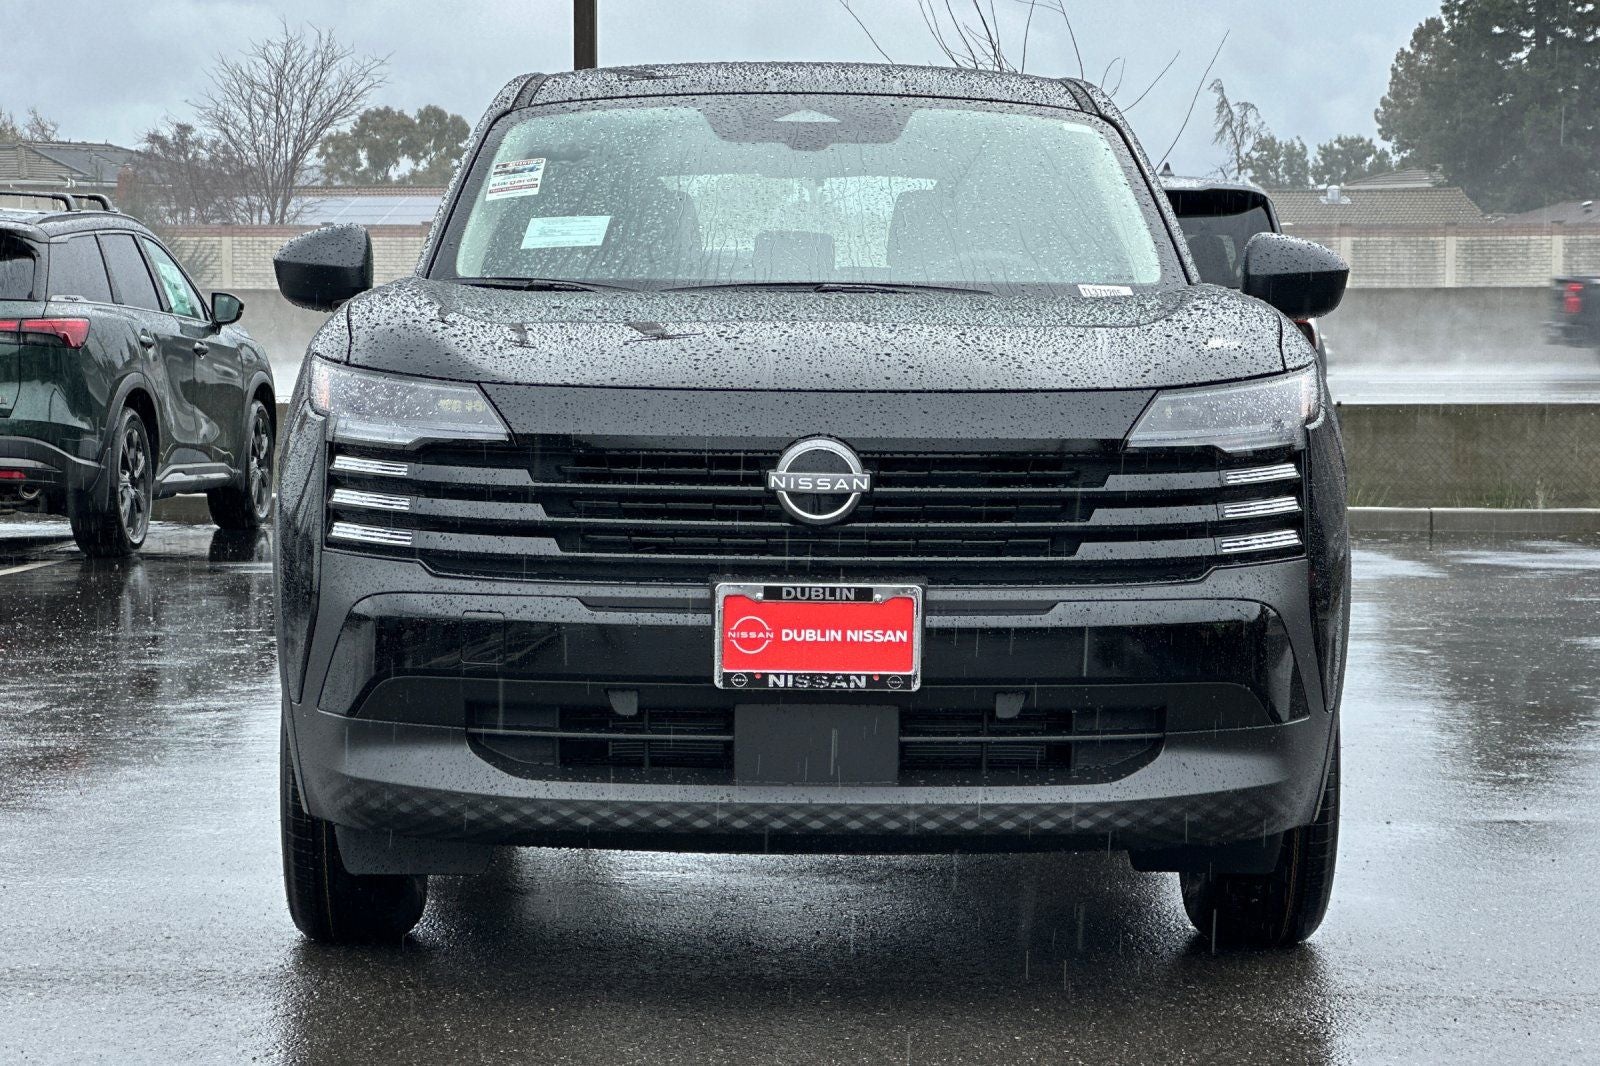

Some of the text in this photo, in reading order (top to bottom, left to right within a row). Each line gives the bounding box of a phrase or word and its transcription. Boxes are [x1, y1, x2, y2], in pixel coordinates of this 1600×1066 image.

[771, 475, 868, 490] NISSAN
[781, 587, 855, 600] DUBLIN
[728, 631, 774, 639] NISSAN
[781, 629, 908, 643] DUBLIN NISSAN
[768, 674, 867, 689] NISSAN
